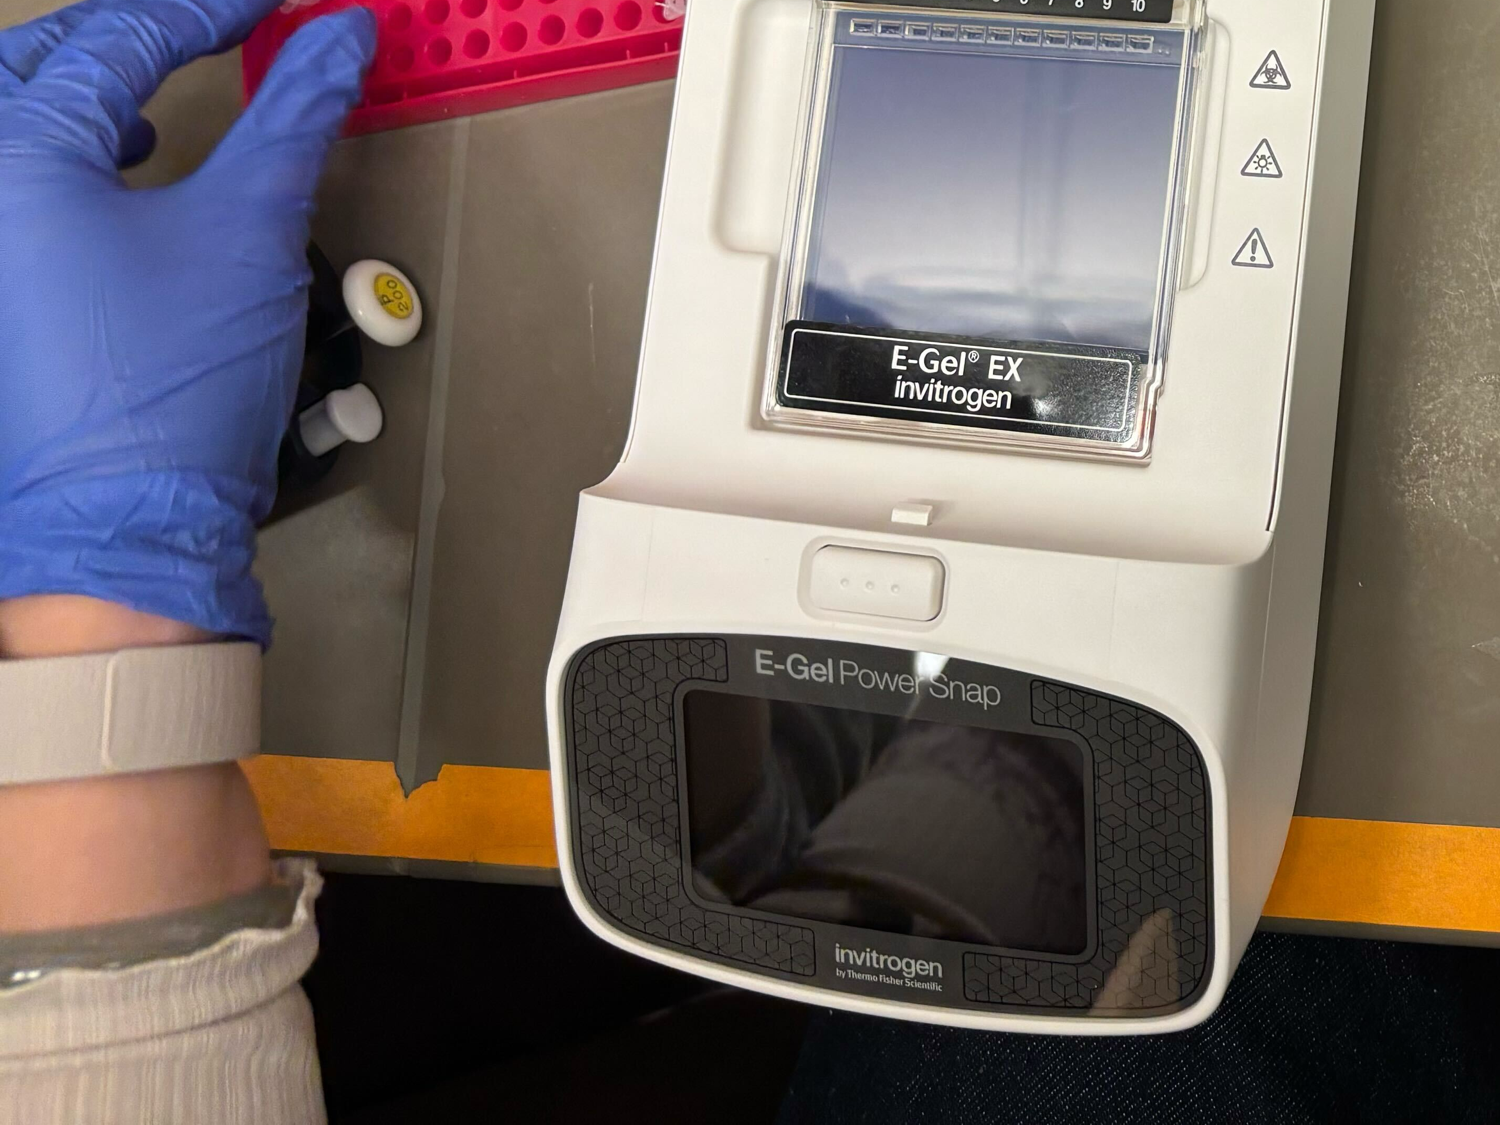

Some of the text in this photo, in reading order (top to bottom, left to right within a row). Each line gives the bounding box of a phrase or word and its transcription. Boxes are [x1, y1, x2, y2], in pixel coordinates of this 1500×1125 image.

[988, 355, 1023, 382] EX
[893, 375, 1012, 412] invitrogen
[755, 648, 834, 684] E-Gel
[835, 943, 943, 978] invitrogen
[836, 967, 943, 992] by Thermo Fisher Scientific
